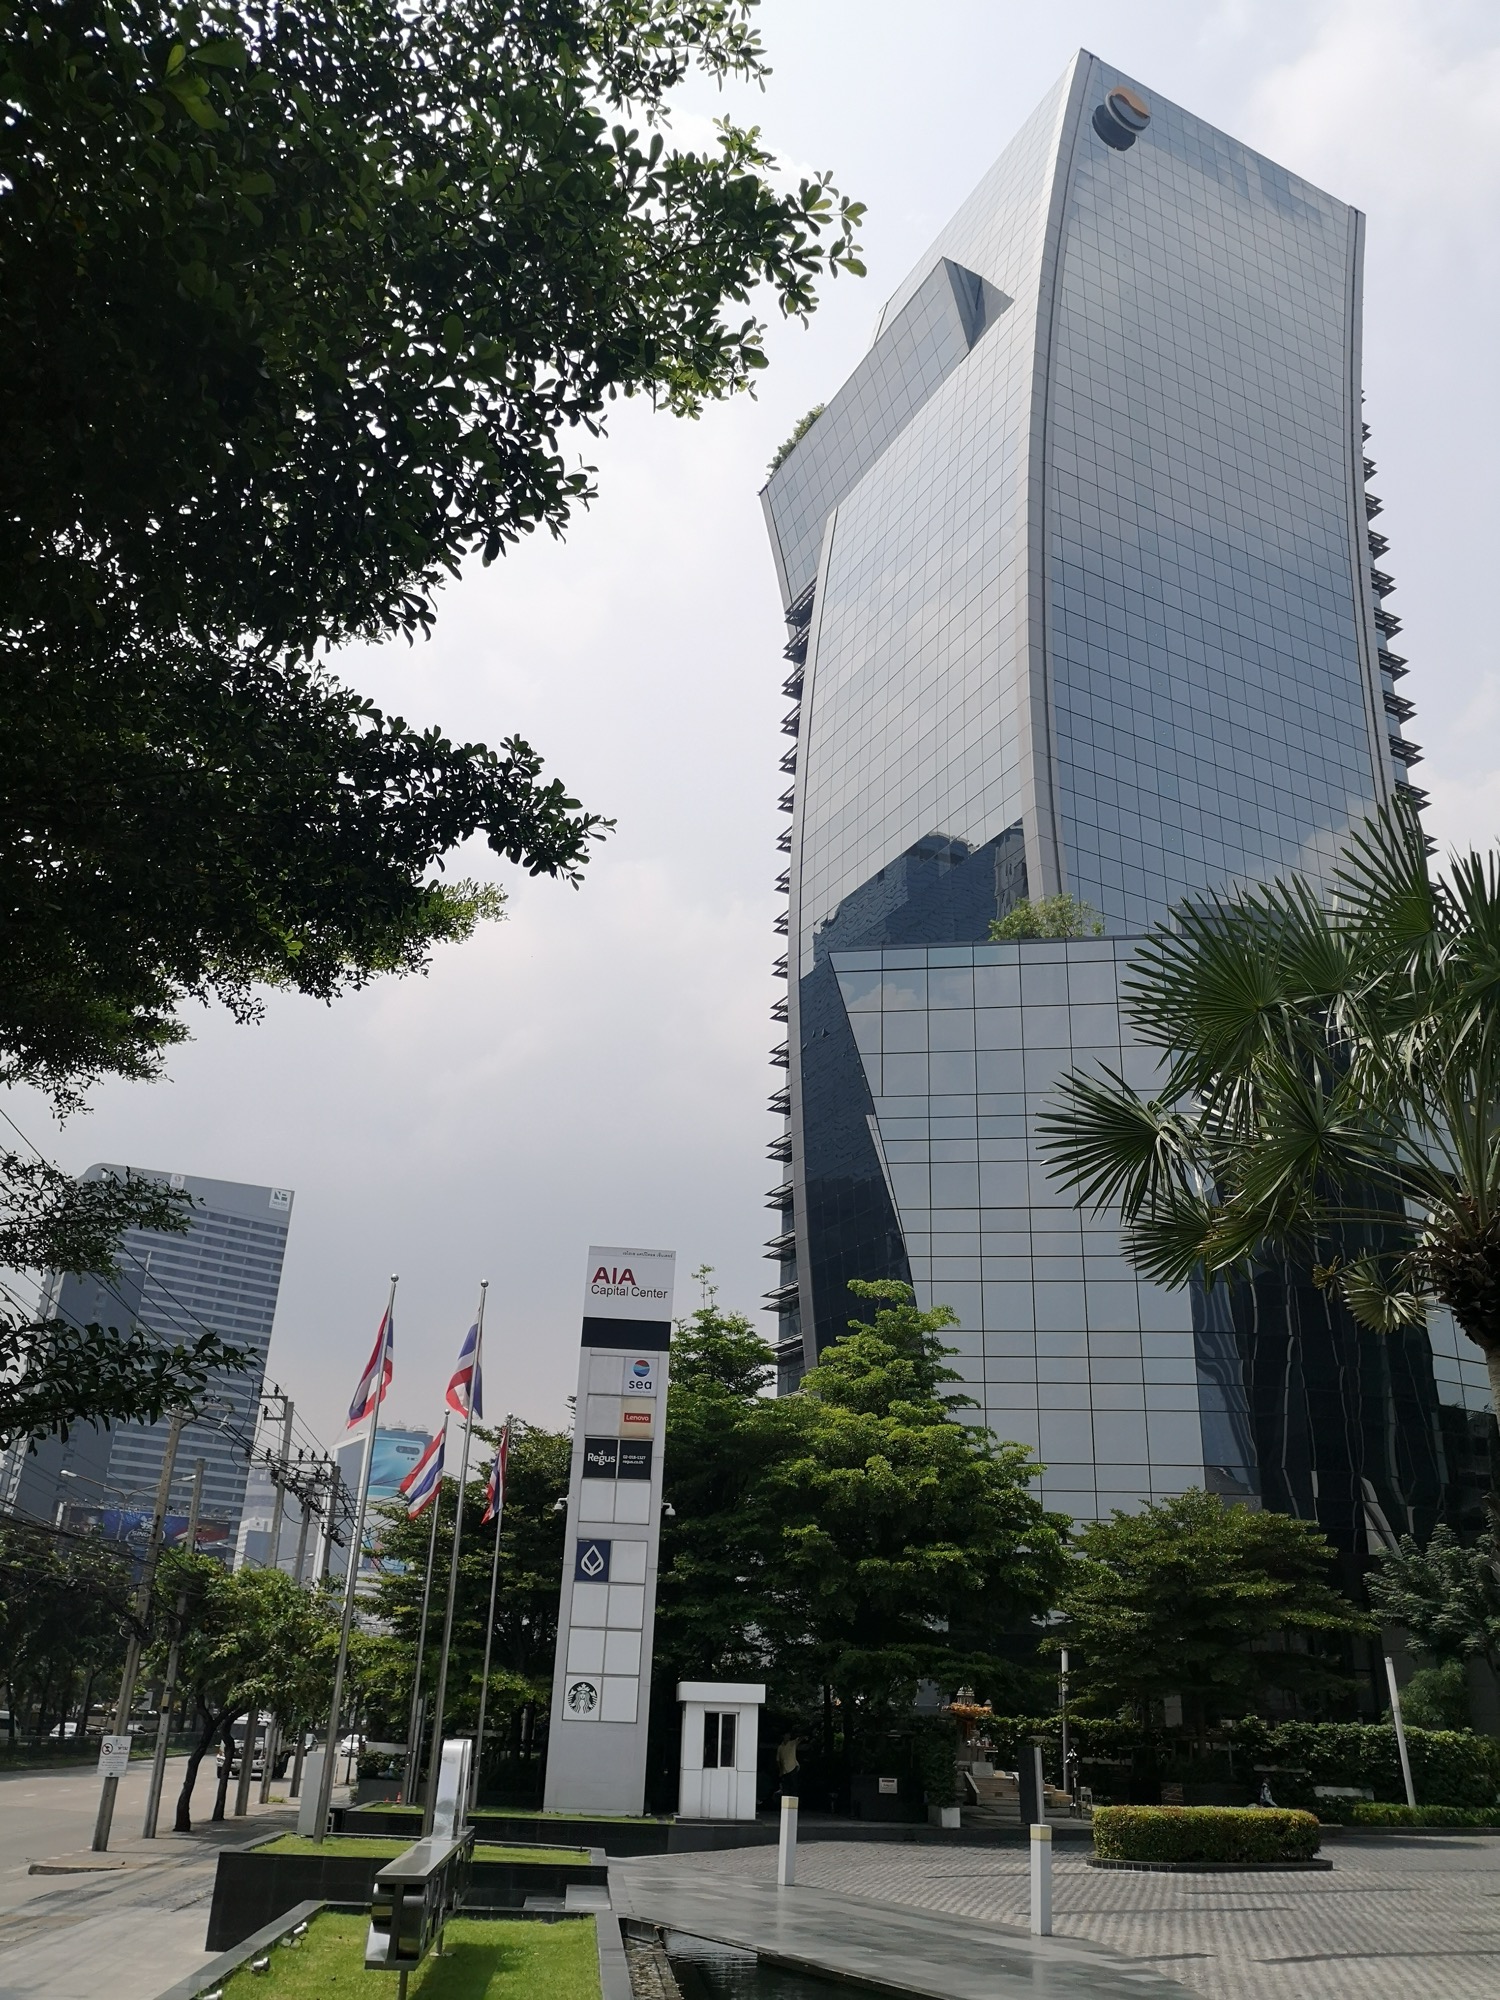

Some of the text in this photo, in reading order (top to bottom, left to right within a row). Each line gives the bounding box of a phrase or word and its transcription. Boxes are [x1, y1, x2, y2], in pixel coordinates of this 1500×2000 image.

[592, 1266, 637, 1286] AIA
[591, 1284, 668, 1299] Capital Center
[628, 1380, 652, 1390] sea
[587, 1451, 616, 1466] Regus
